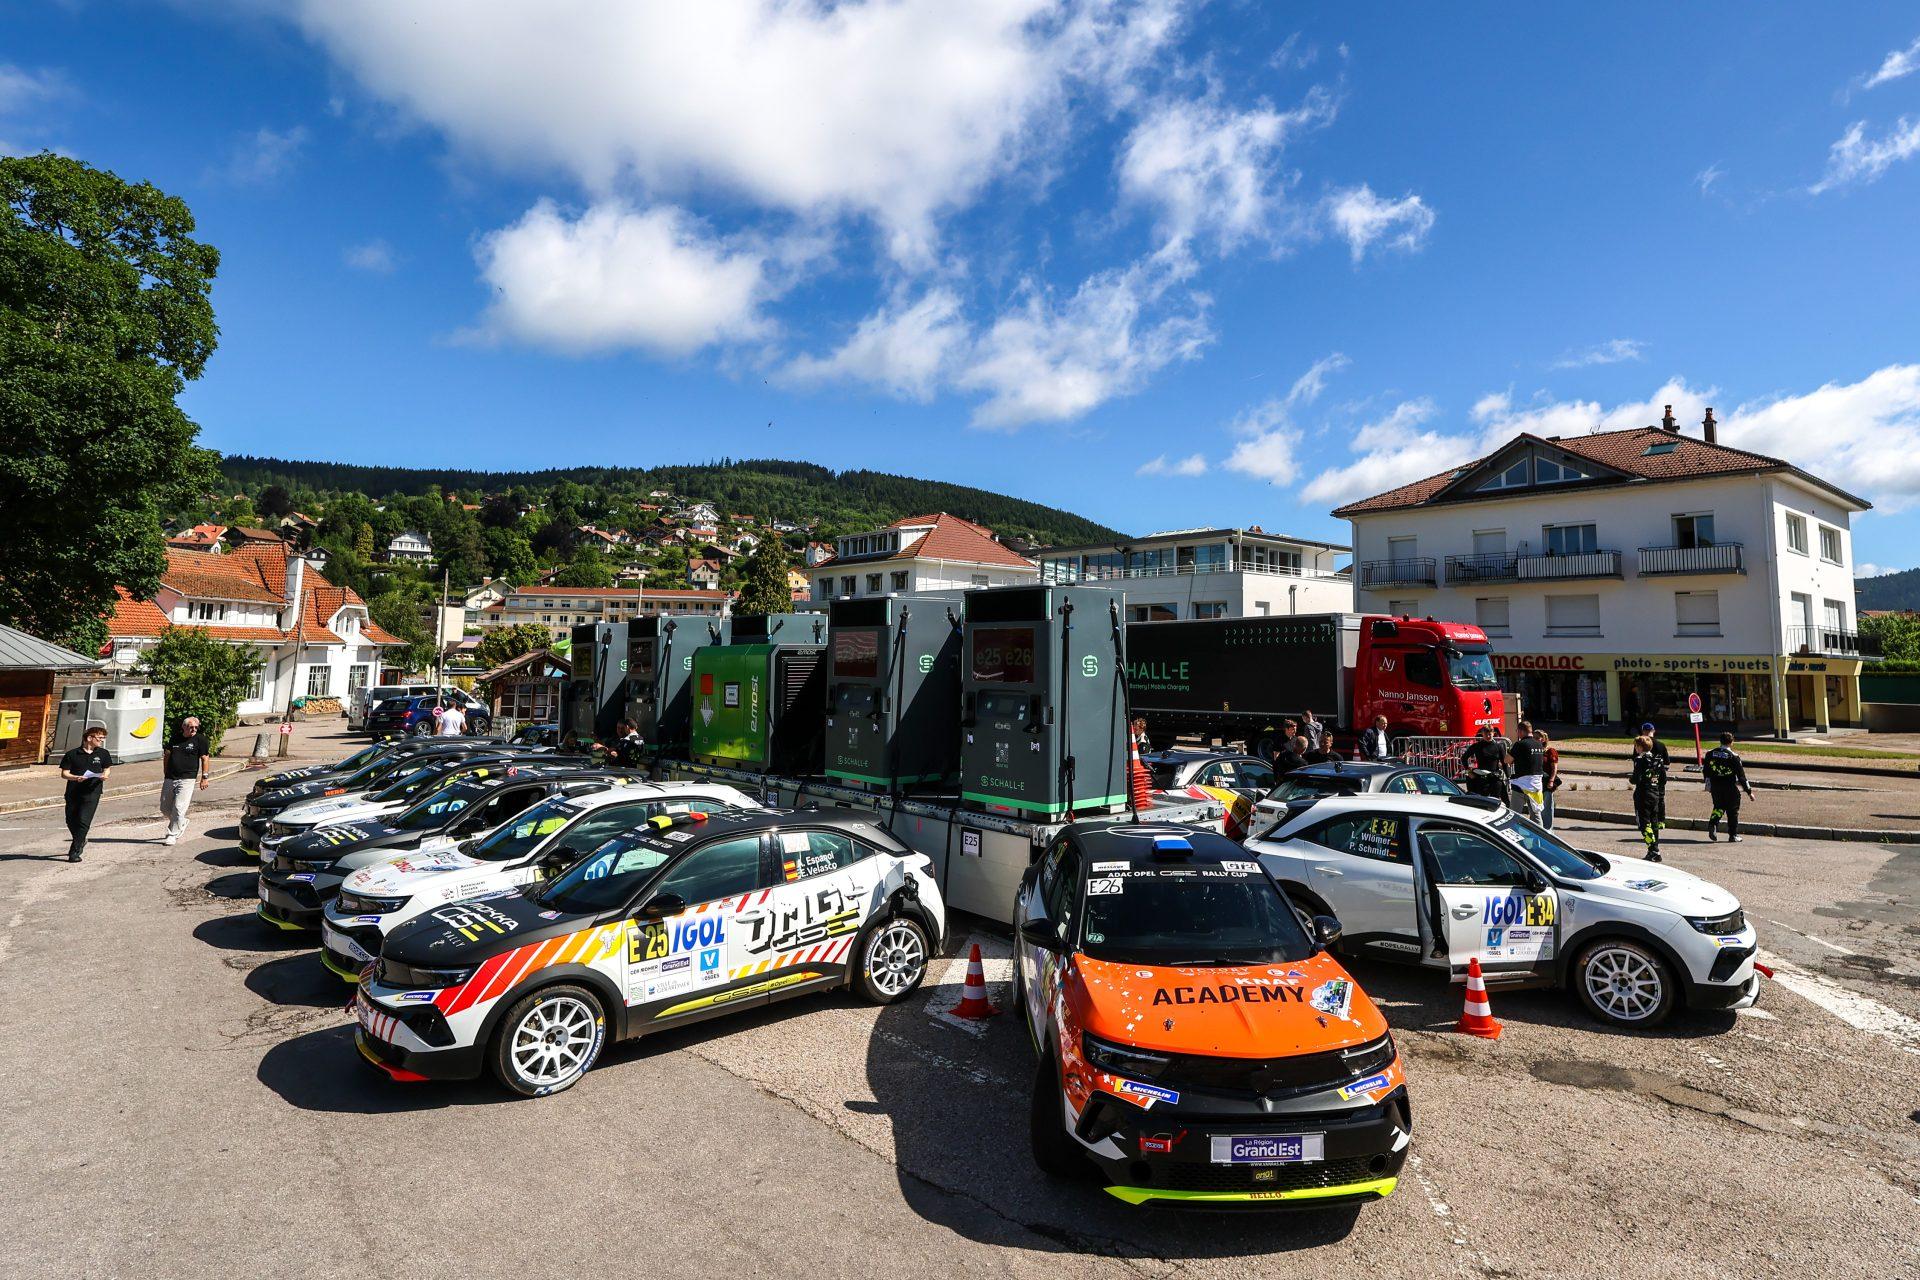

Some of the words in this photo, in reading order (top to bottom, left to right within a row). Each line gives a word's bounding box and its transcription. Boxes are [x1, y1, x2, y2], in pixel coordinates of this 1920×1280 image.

[976, 647, 1001, 665] e25
[1126, 662, 1189, 679] HALL-E
[1614, 659, 1651, 670] photo
[1664, 659, 1710, 670] sports
[1722, 659, 1770, 672] jouets
[1167, 683, 1189, 692] Charging
[1378, 689, 1404, 699] Nanno
[1406, 691, 1439, 702] Janssen
[844, 757, 868, 767] SCHALL-E
[990, 778, 1025, 791] SCHALL-E
[324, 788, 346, 797] HERO
[1371, 819, 1379, 834] E
[1381, 820, 1396, 836] 34
[965, 834, 978, 847] E25
[1358, 843, 1389, 857] Schmidt
[1089, 879, 1120, 894] E26
[1483, 895, 1524, 925] IGOL
[1527, 896, 1535, 925] E
[1537, 896, 1554, 926] 34
[628, 927, 640, 963] E
[645, 923, 668, 960] 25
[672, 914, 725, 953] IGOL
[1088, 934, 1103, 942] FIA
[1234, 977, 1300, 986] KNAF
[1153, 984, 1304, 1006] ACADEMY
[584, 1028, 604, 1071] MICHELIN
[1354, 1079, 1383, 1092] MICHELIN
[1132, 1086, 1171, 1099] MICHELIN
[1253, 1139, 1273, 1147] Région
